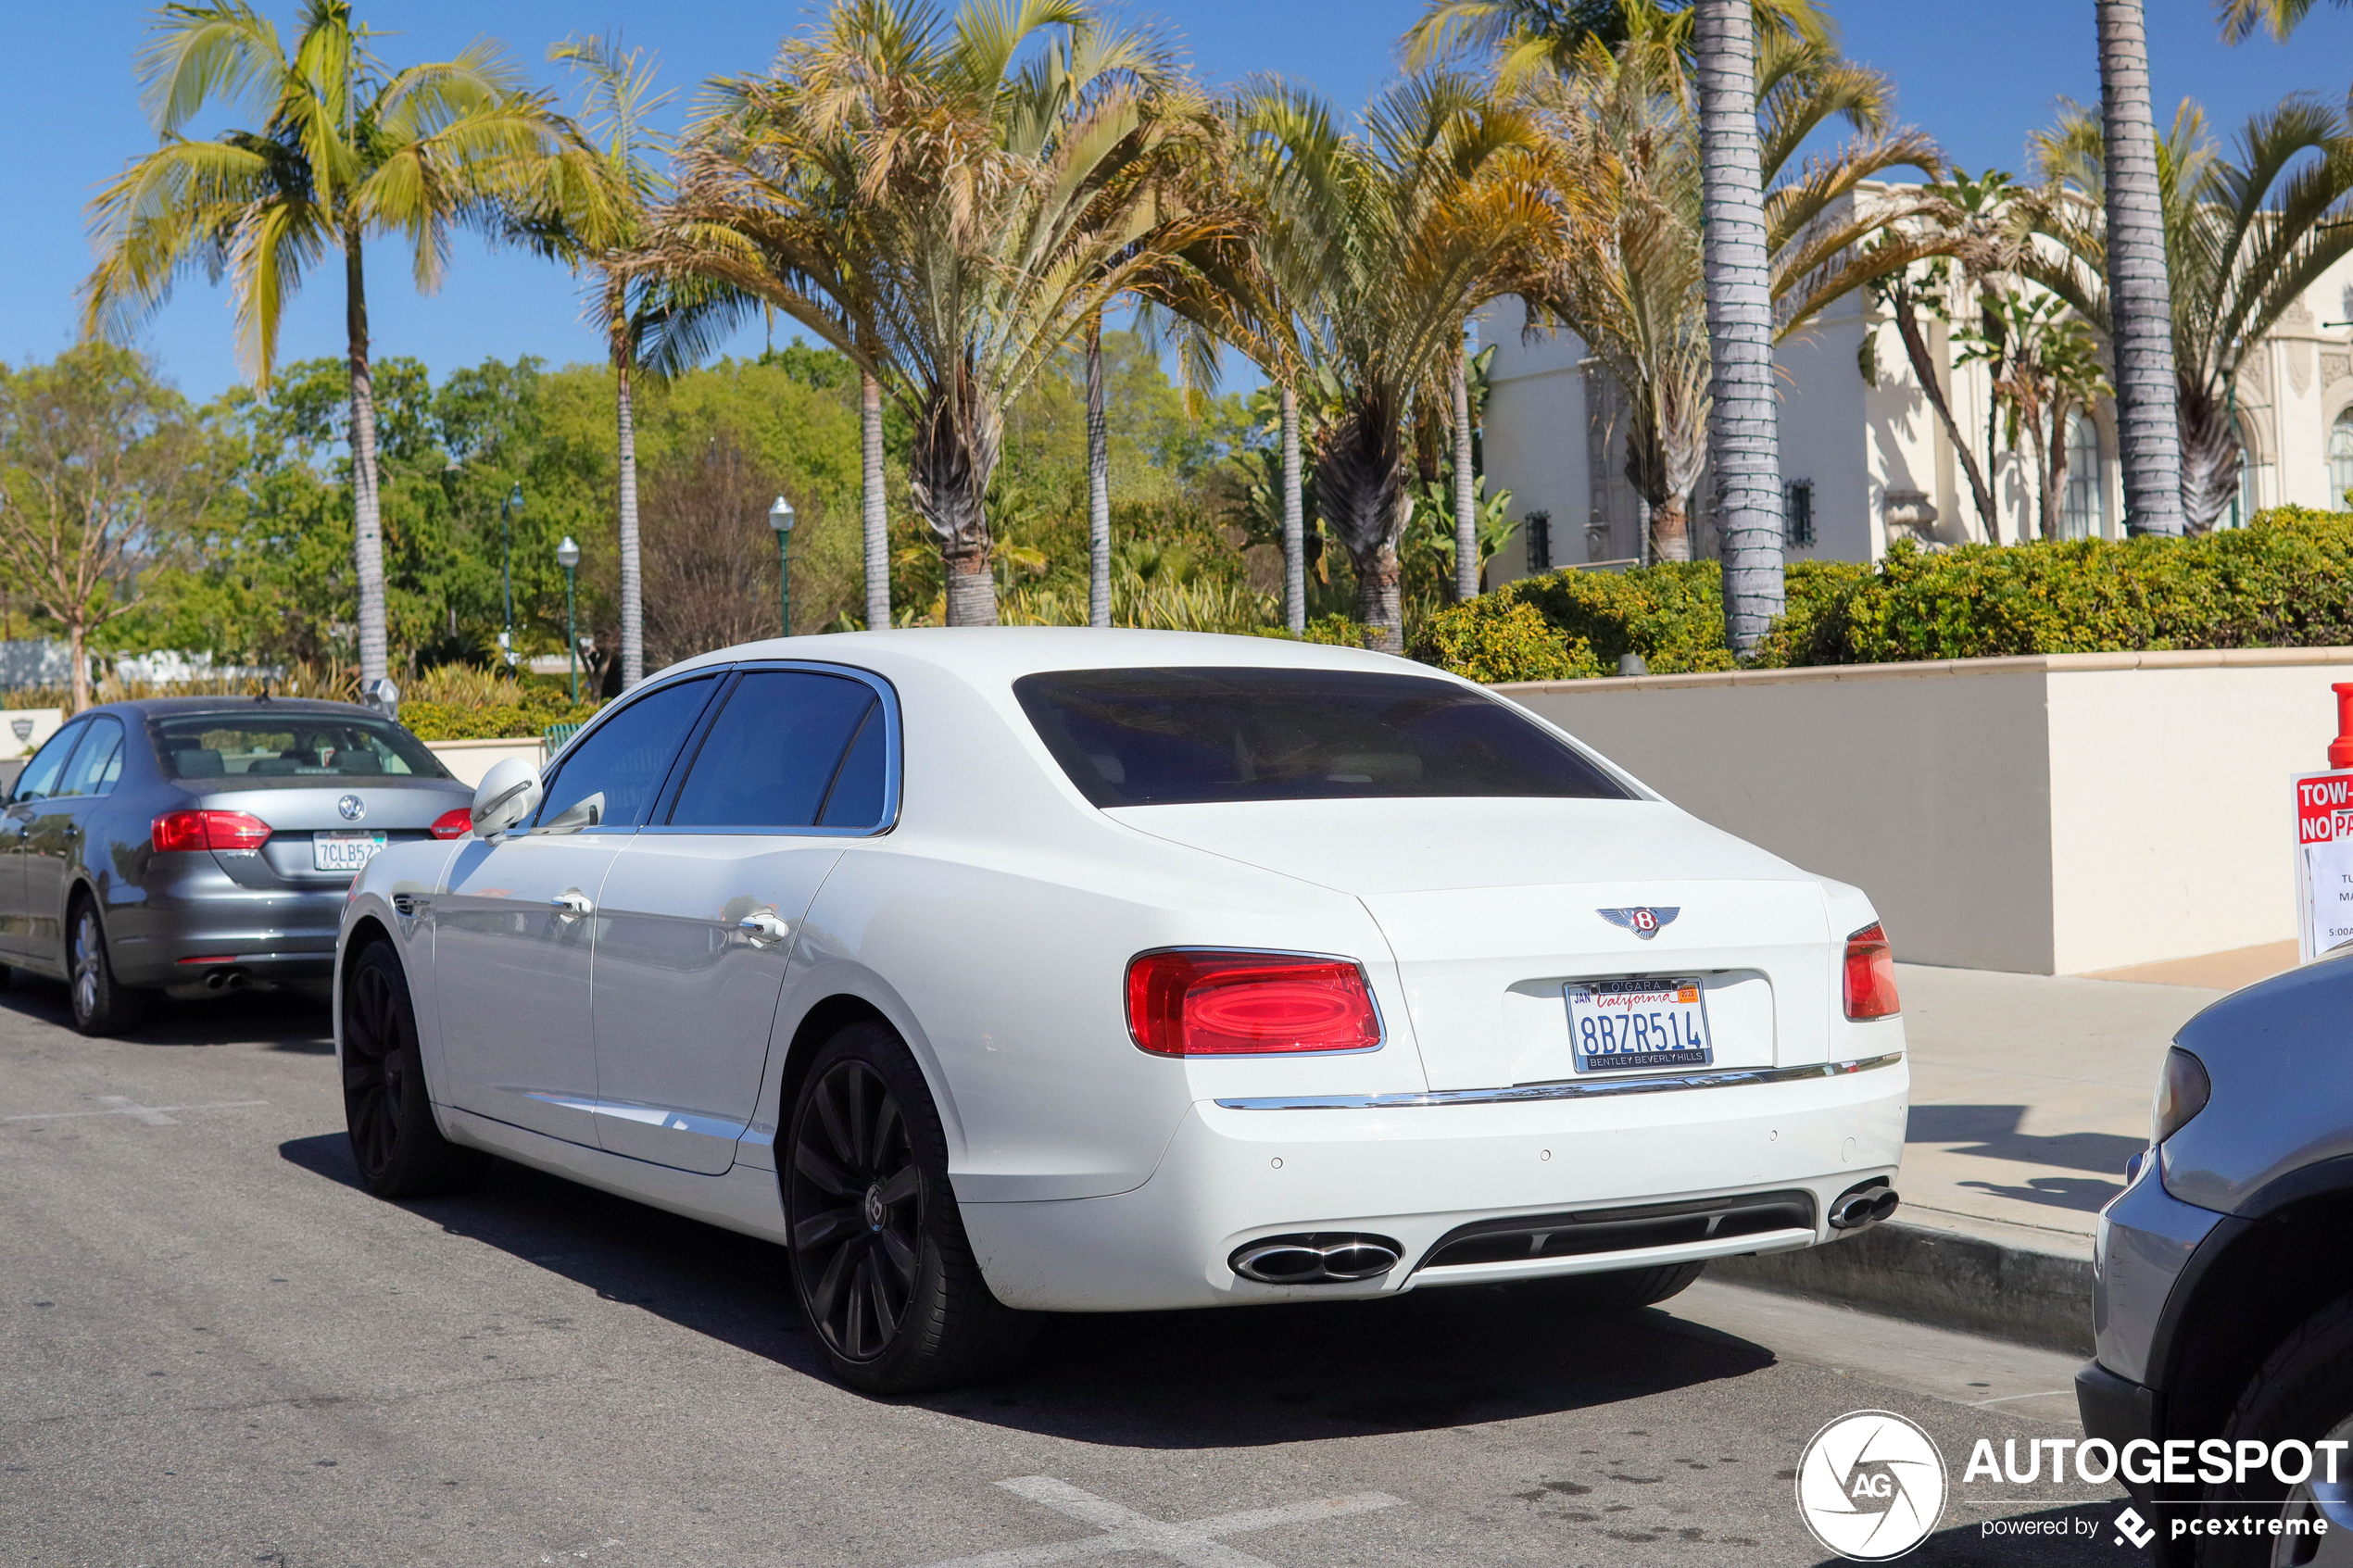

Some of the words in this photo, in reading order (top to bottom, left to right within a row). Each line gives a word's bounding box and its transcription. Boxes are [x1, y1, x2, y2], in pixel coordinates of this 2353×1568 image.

[2302, 816, 2331, 839] NO
[1612, 981, 1661, 992] O'GARA
[1575, 992, 1591, 1005] JAN
[1596, 993, 1676, 1011] California
[1580, 1010, 1702, 1055] 8BZR514
[1590, 1057, 1633, 1067] BENTLEY
[1635, 1054, 1675, 1064] BEVERLY
[1677, 1052, 1703, 1061] HILLS
